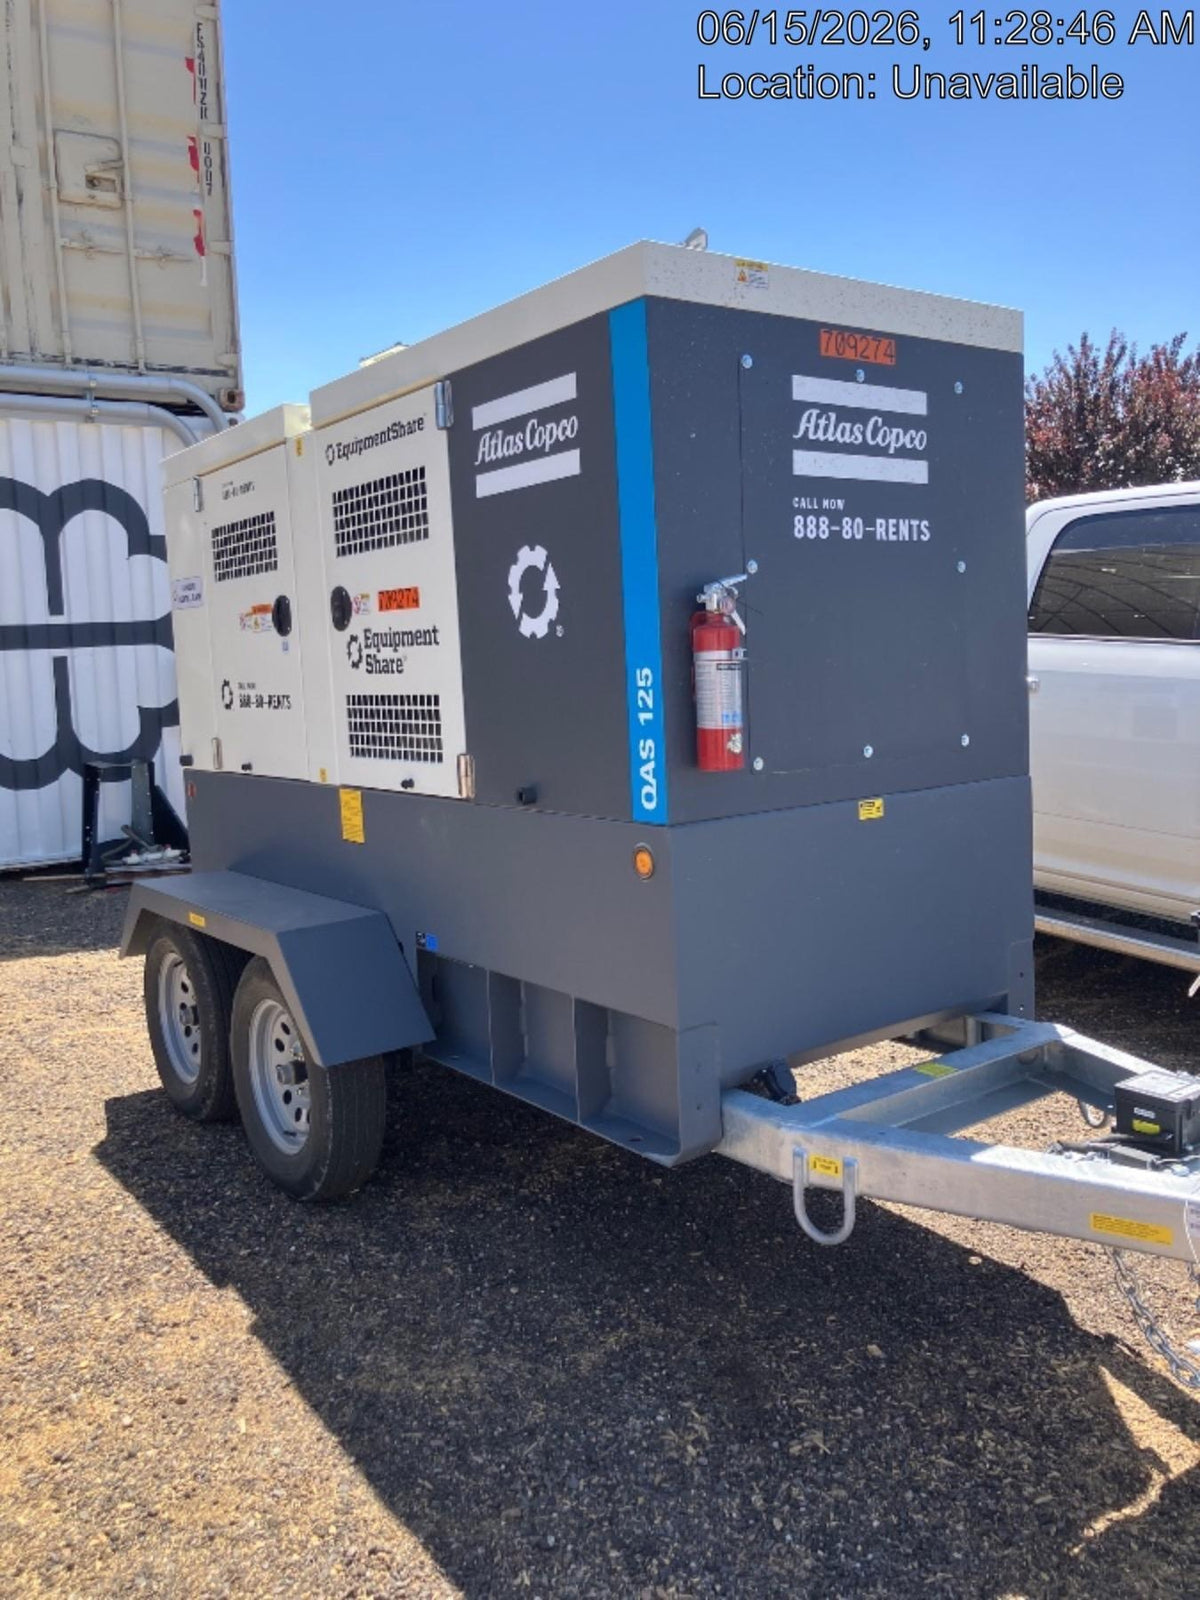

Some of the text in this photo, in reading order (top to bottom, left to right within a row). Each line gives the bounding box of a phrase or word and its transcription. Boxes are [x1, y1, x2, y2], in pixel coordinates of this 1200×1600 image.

[821, 329, 894, 364] 709274
[335, 416, 425, 461] EquipmentShare
[474, 415, 578, 466] Atlas Copco
[792, 408, 928, 454] Atlas Copco
[792, 497, 846, 511] CALL NOW
[793, 514, 931, 542] 888-80-RENTS
[363, 624, 440, 653] Equipment
[365, 653, 405, 675] Share
[635, 666, 658, 811] QAS 125
